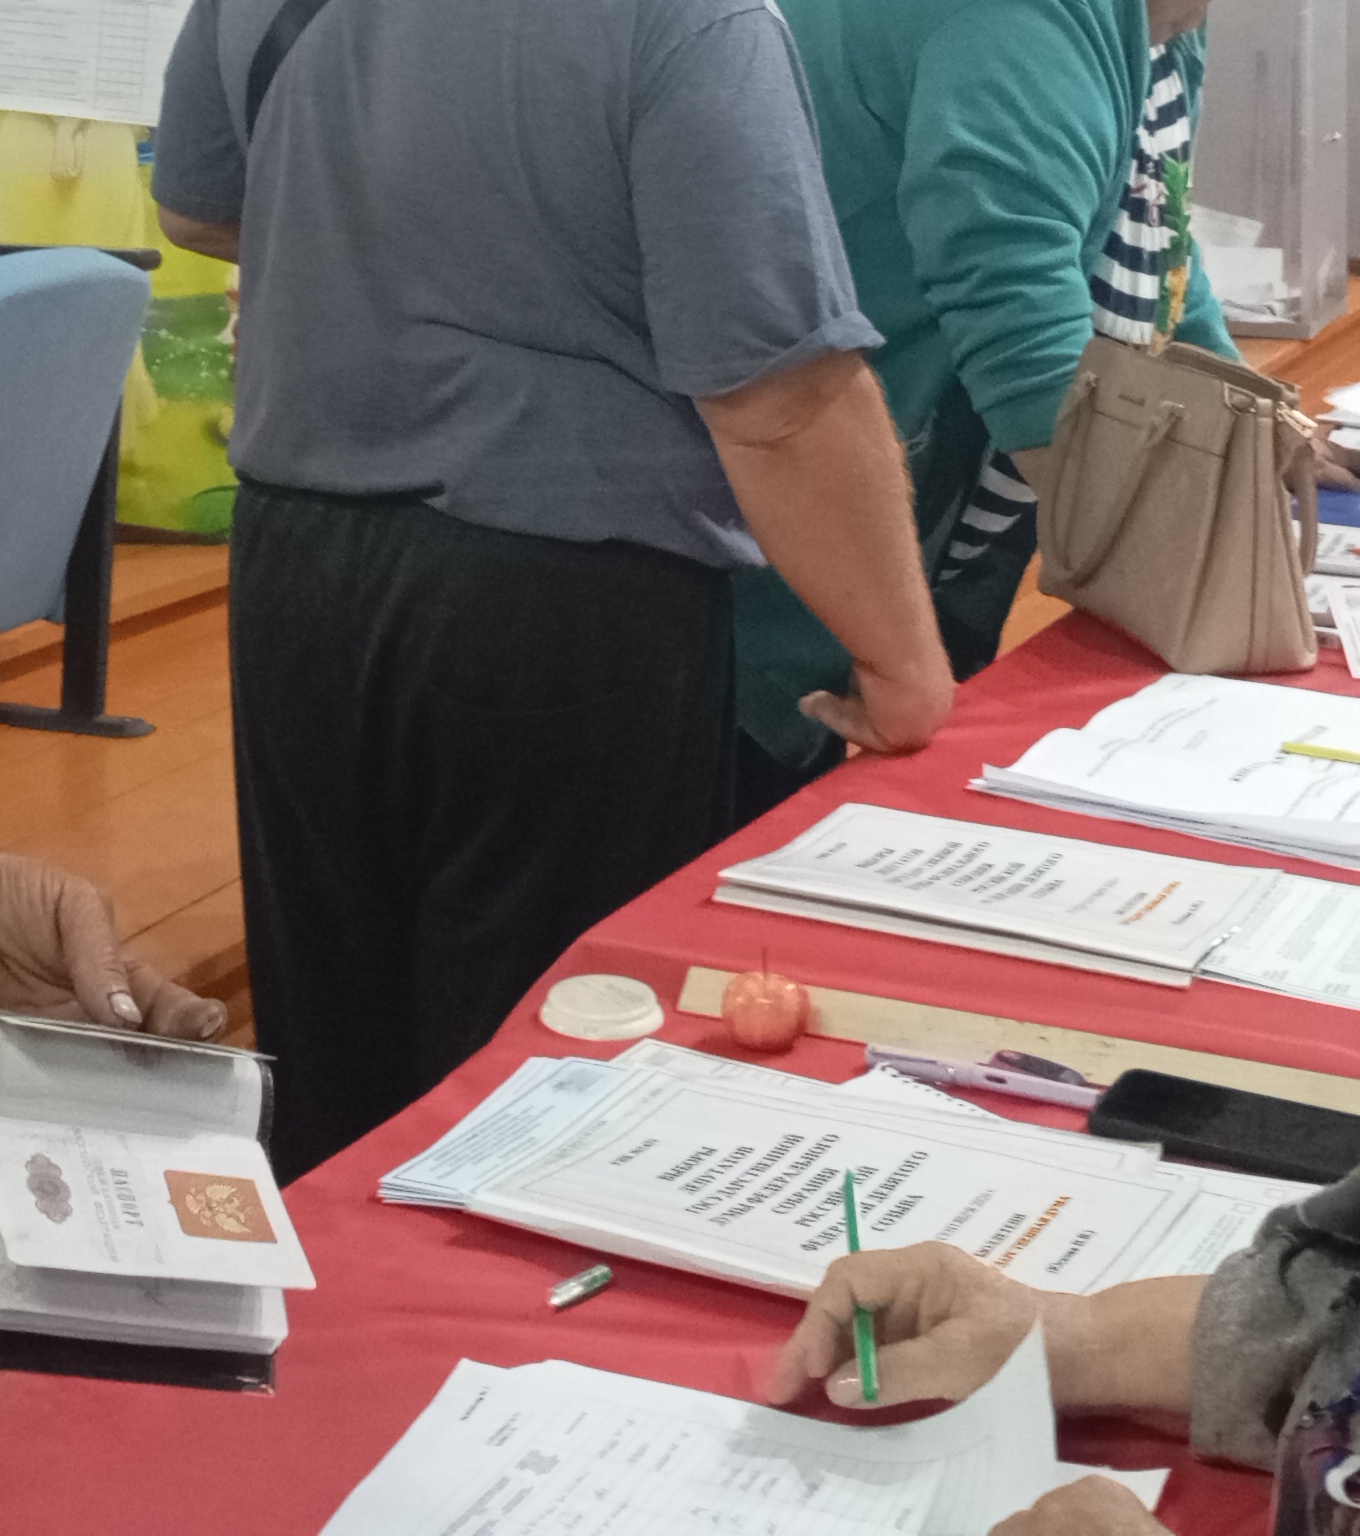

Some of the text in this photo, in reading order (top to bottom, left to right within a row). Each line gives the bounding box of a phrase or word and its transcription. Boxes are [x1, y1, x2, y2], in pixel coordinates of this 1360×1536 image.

[657, 1145, 719, 1183] ВЫБОРЫ
[679, 1144, 755, 1195] ДЕПУТАТОВ
[683, 1133, 806, 1216] ГОСУДАРСТВЕННОЙ
[707, 1133, 842, 1227] ДУМЫ ФЕДЕРАЛЬНОГО
[867, 1150, 930, 1204] ДЕВЯТОГО
[109, 1167, 145, 1228] ПАСПОРТ
[771, 1167, 840, 1216] СОБРАНИЯ
[794, 1165, 879, 1228] РОССИЙОЙ
[870, 1194, 925, 1233] СОЗЫВА
